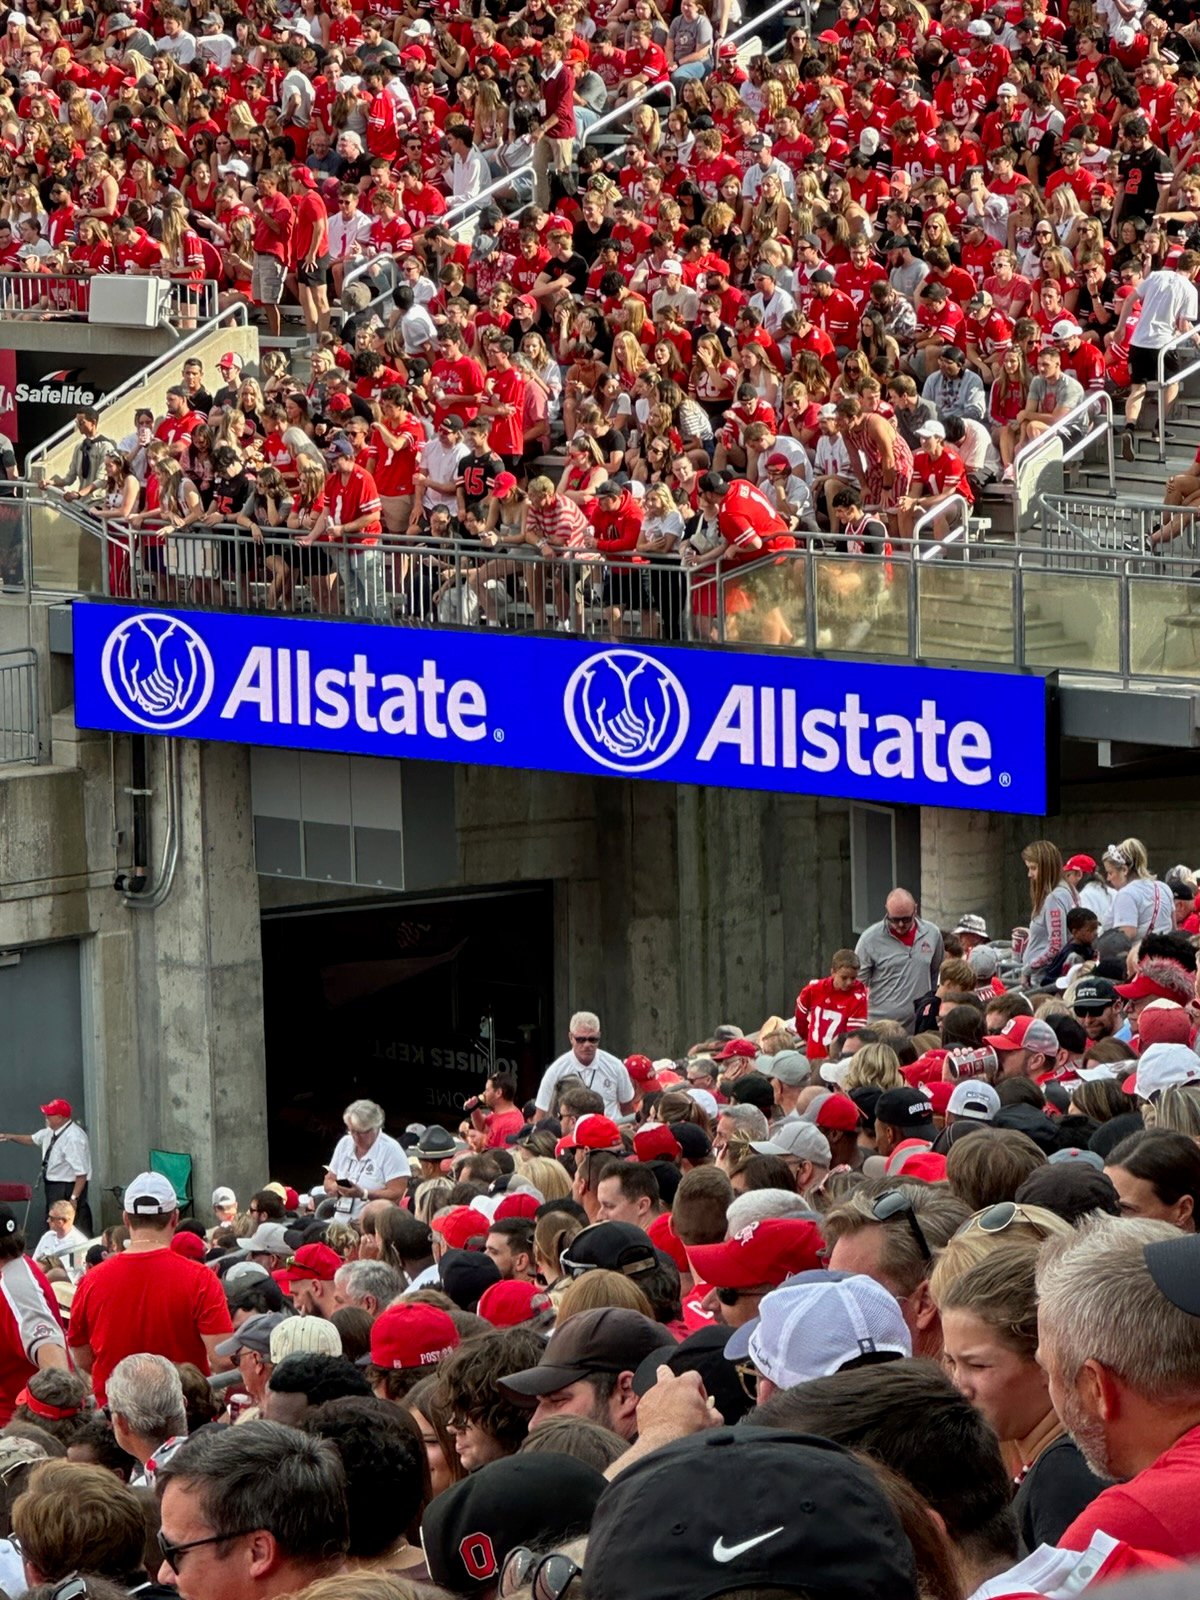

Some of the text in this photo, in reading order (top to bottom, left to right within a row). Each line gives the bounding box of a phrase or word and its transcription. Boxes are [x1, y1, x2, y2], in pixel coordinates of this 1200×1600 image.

[949, 163, 956, 185] 1
[1125, 168, 1142, 194] 2
[338, 233, 348, 257] 1
[851, 289, 864, 309] 7
[15, 384, 94, 406] Safelite
[463, 467, 484, 495] 15
[334, 494, 343, 522] 1
[751, 491, 776, 519] 1
[219, 646, 487, 742] Allstate
[696, 685, 992, 786] Allstate
[811, 1008, 842, 1048] 17
[420, 1350, 440, 1365] POST
[458, 1531, 498, 1580] O
